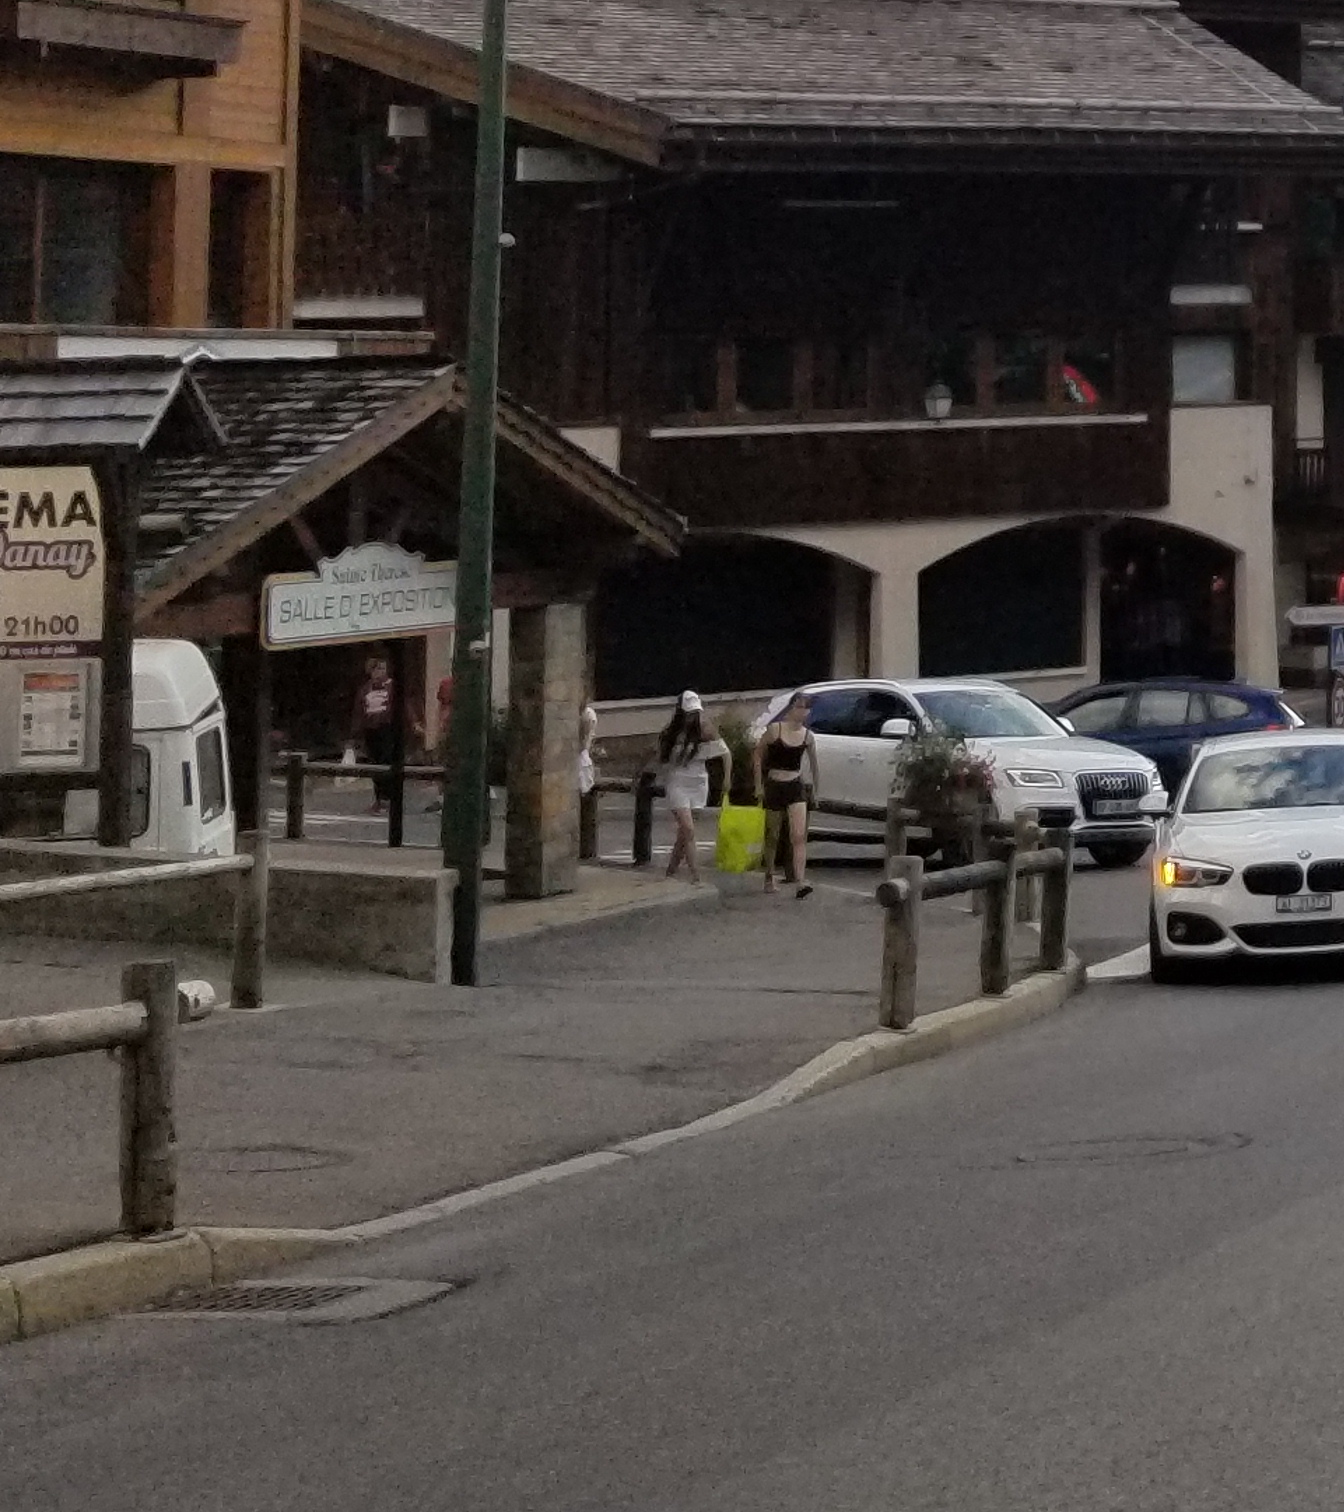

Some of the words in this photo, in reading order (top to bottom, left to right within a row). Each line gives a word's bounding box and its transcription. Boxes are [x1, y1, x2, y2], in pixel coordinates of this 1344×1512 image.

[0, 532, 96, 579] anay
[279, 596, 335, 624] SALLE
[4, 614, 80, 637] 21h00
